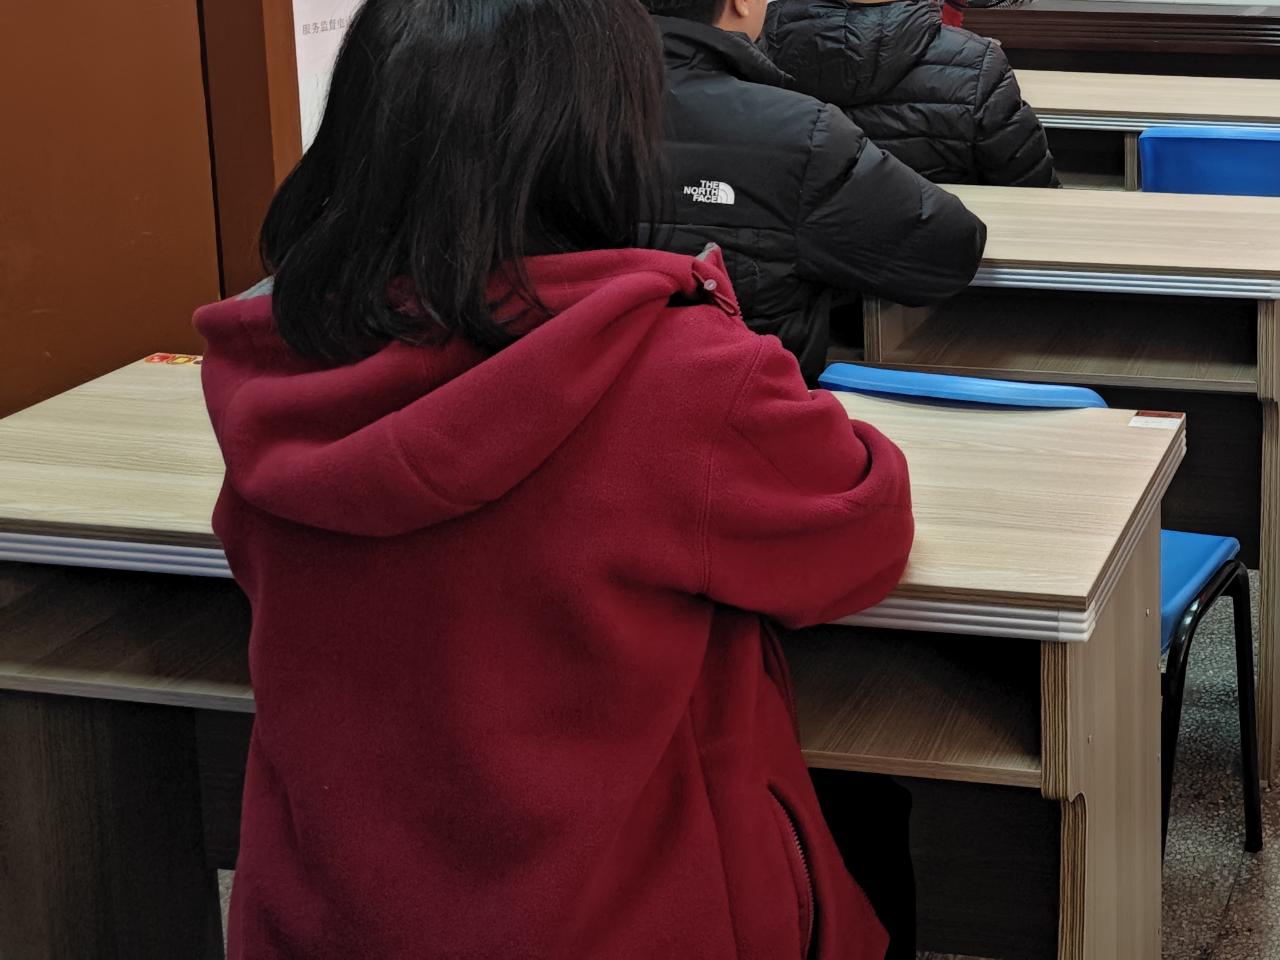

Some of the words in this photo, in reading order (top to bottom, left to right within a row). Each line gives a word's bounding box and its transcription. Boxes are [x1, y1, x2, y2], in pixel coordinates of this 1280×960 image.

[700, 180, 720, 189] THE
[683, 186, 719, 196] NORTH
[692, 194, 719, 204] FACE
